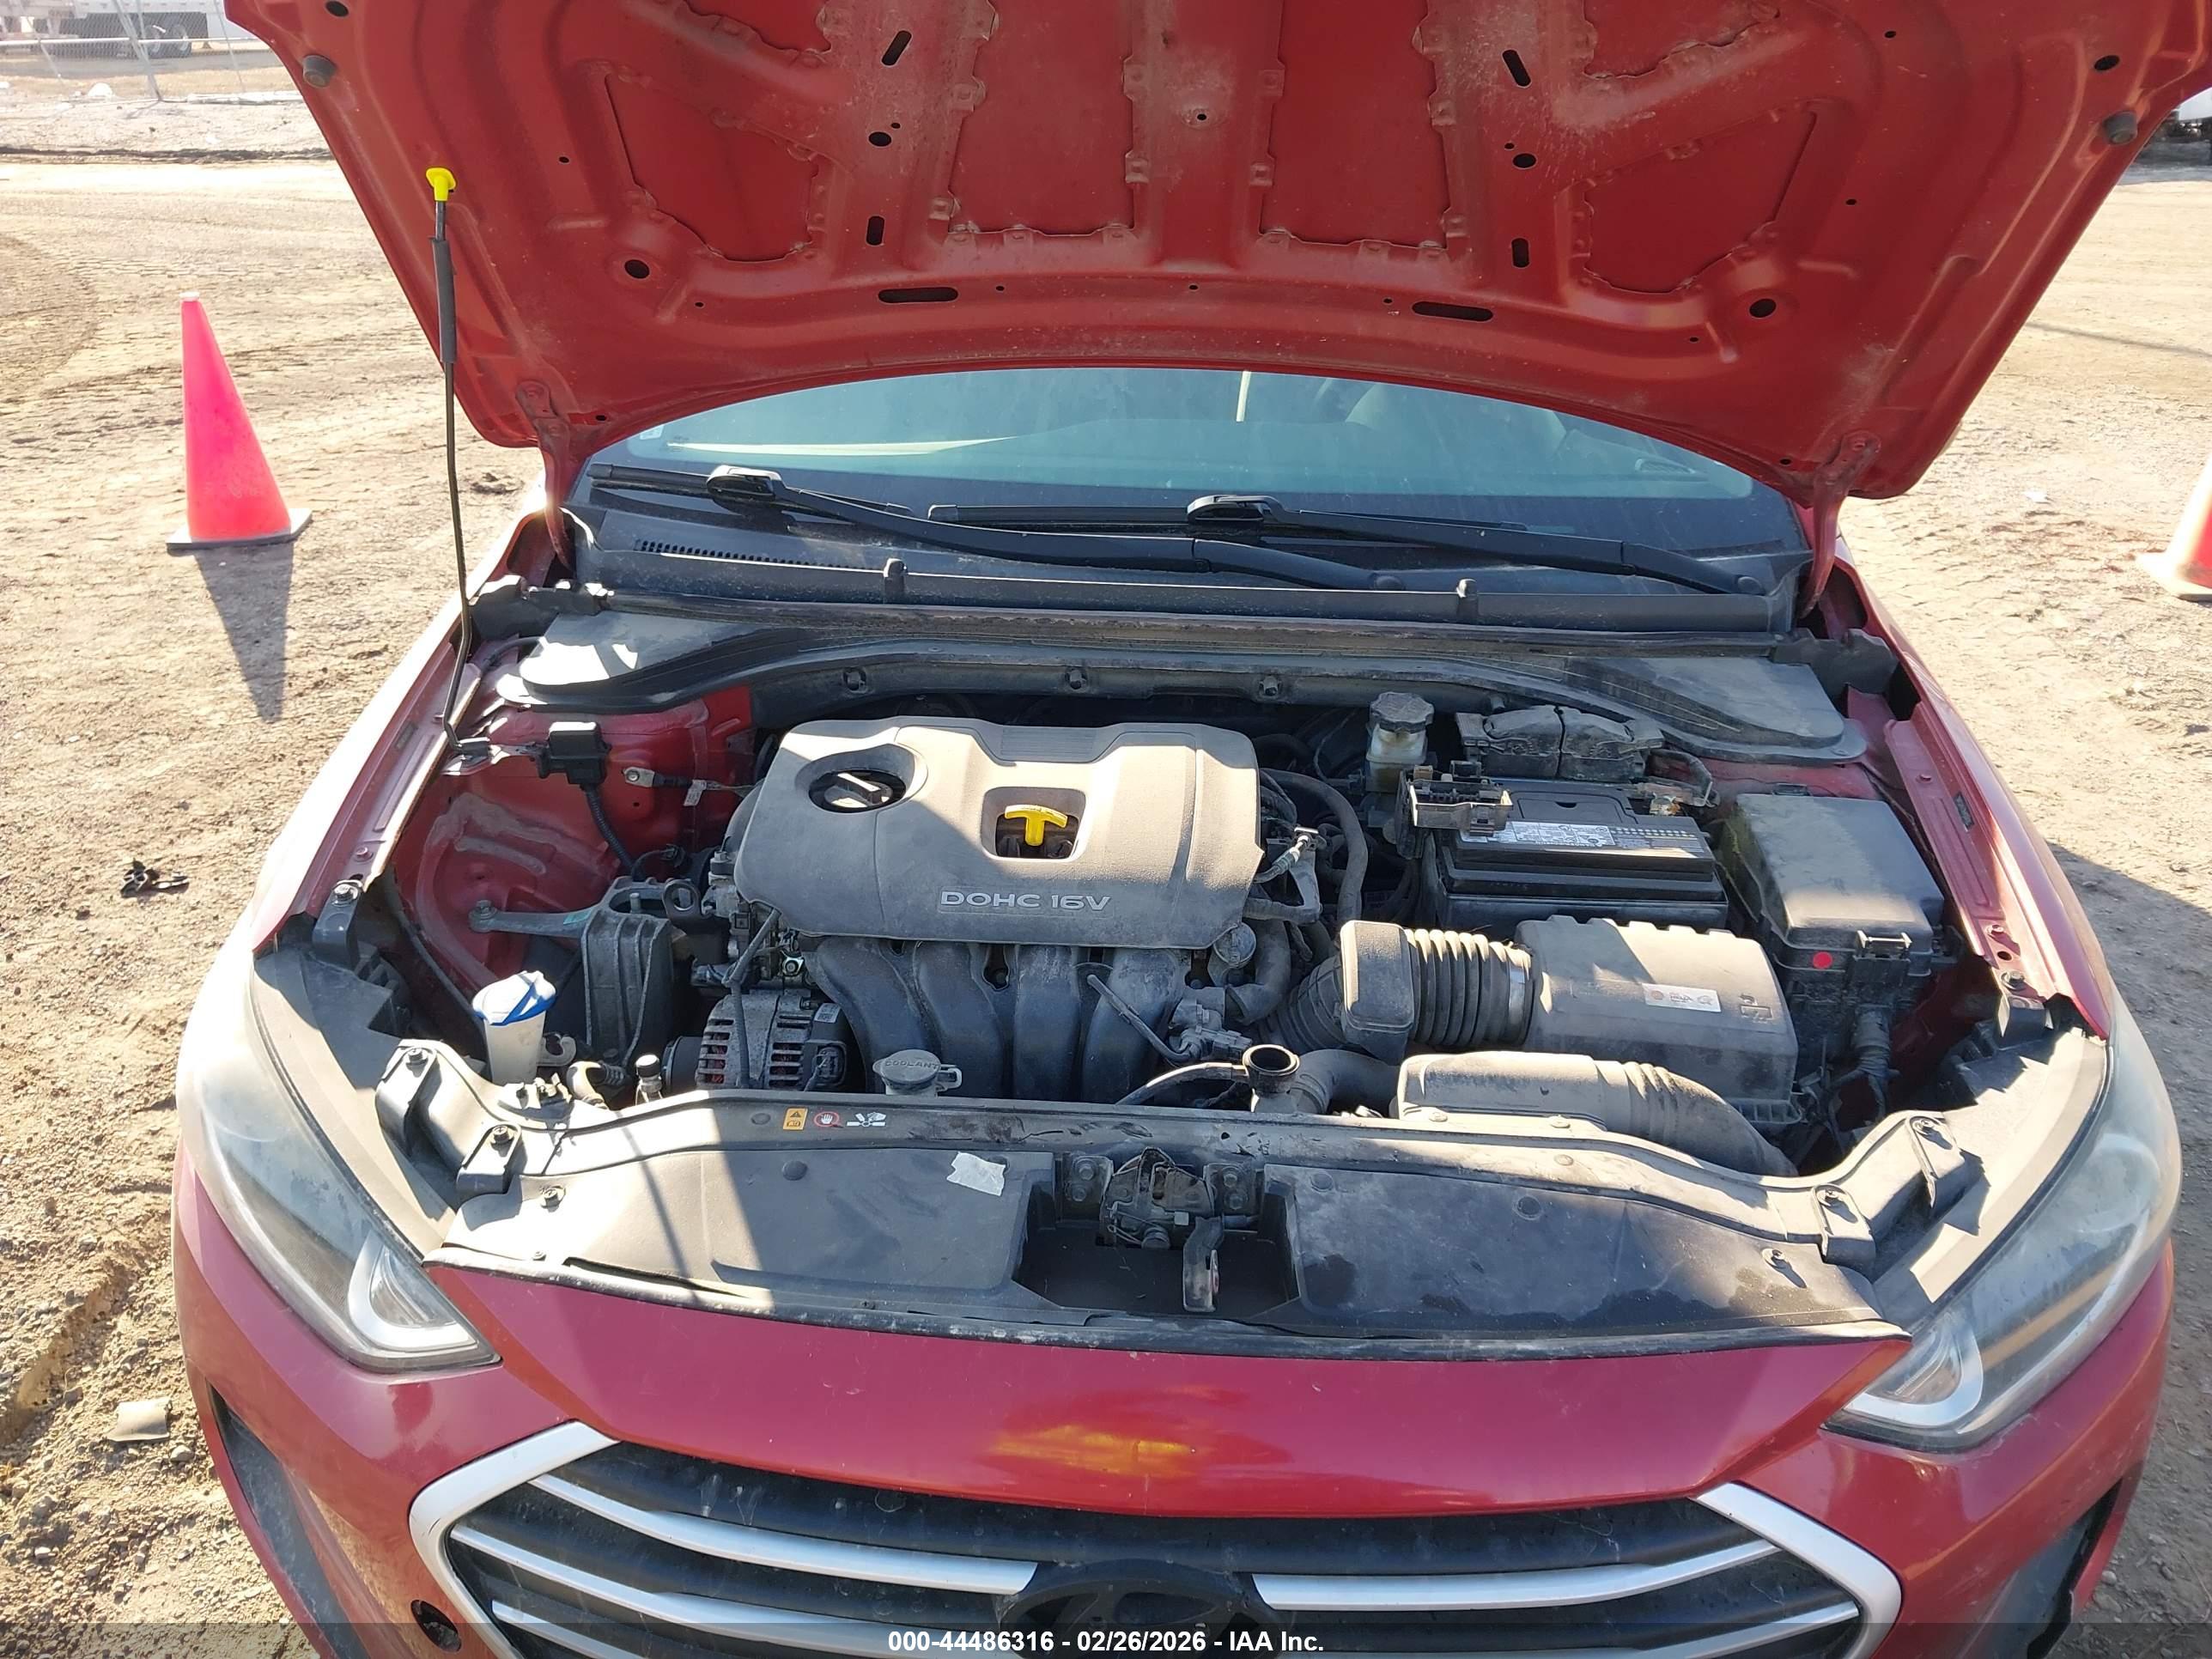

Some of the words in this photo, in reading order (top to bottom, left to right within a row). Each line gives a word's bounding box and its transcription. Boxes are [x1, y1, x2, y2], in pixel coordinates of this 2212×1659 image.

[939, 890, 1041, 908] DOHC
[1050, 894, 1112, 912] 16V
[885, 1060, 940, 1070] COOLANT
